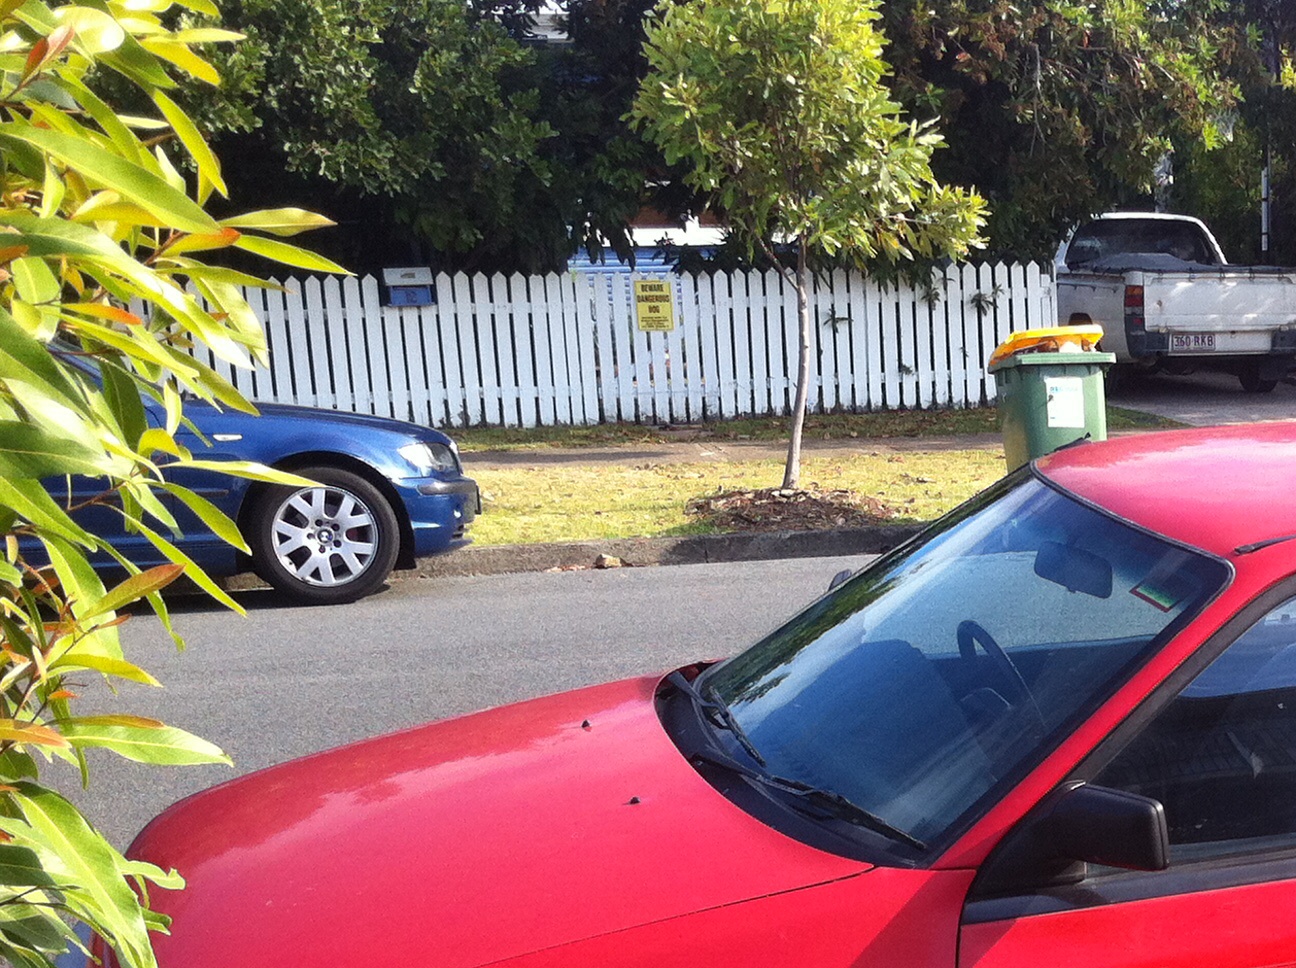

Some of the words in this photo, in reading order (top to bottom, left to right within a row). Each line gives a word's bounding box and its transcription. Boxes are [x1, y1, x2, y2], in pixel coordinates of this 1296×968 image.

[641, 284, 664, 292] BEWARE
[637, 295, 670, 303] DANGEROUS
[648, 305, 660, 313] DOG
